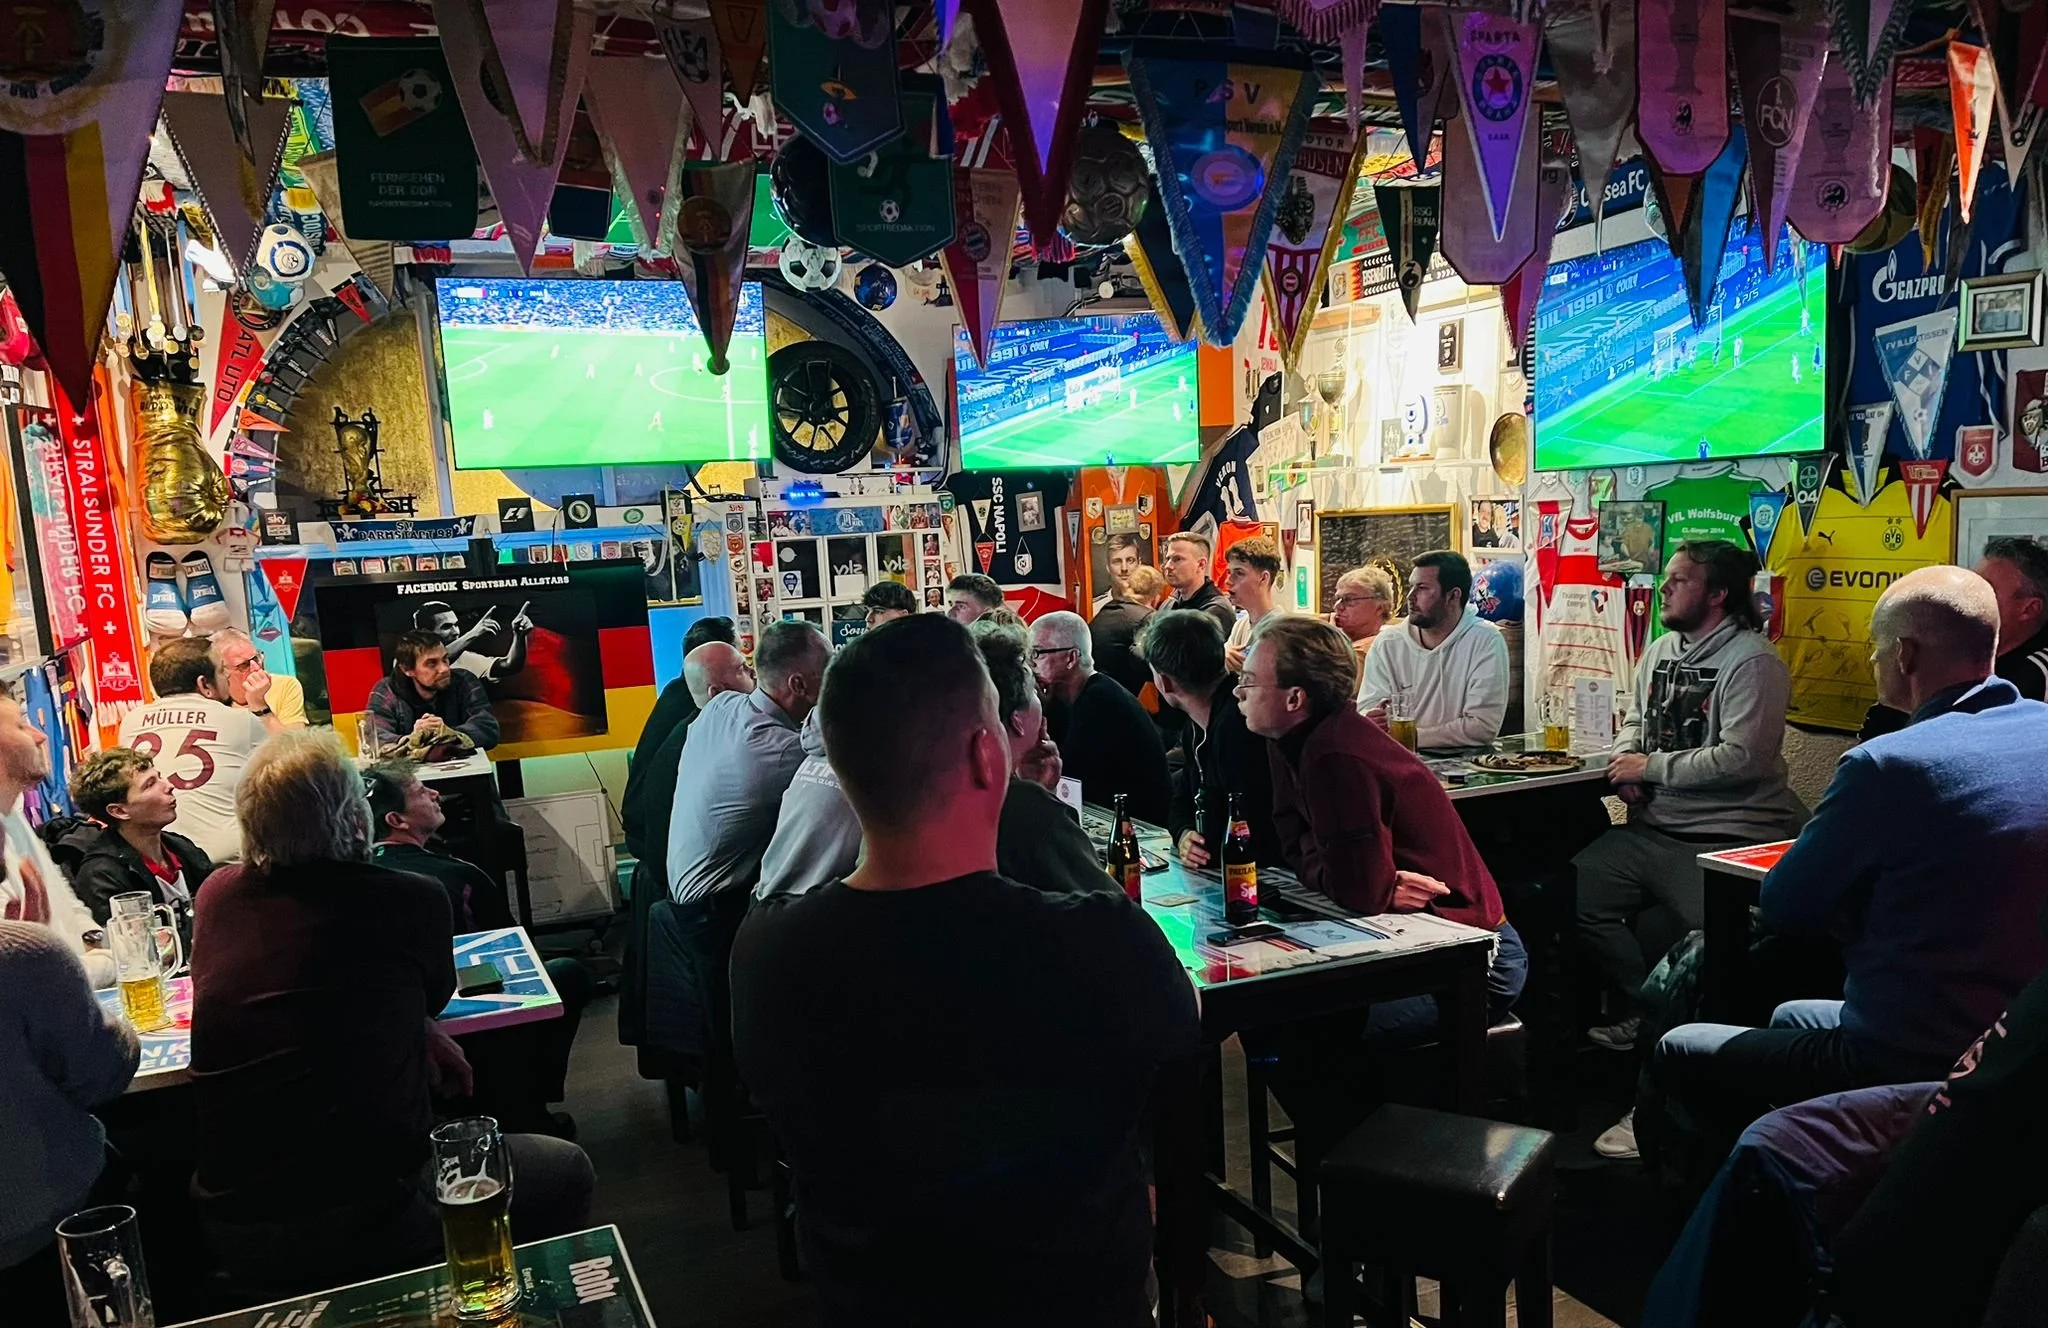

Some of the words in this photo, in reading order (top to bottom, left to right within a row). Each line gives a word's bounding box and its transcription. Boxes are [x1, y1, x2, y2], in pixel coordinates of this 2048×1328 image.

[1470, 30, 1520, 42] SPARTA
[1761, 104, 1794, 135] FCN
[1306, 134, 1344, 148] OTOR
[1297, 150, 1345, 175] AUSEN
[370, 172, 445, 184] FERNSEHEN
[1628, 169, 1645, 194] FC
[379, 185, 405, 196] DER
[410, 185, 438, 196] DDR
[855, 223, 936, 234] SPORTREDAKTION
[1896, 271, 1960, 300] GAZPRO
[1567, 287, 1604, 318] 1991
[1742, 288, 1759, 304] PS5
[230, 329, 255, 360] ATL
[1616, 359, 1635, 374] PS5
[216, 365, 243, 403] UTD
[1215, 460, 1237, 488] VERON
[992, 477, 1004, 504] SSC
[1797, 489, 1818, 504] 04
[72, 439, 112, 577] STRALSUNDER
[95, 583, 116, 609] FC
[267, 514, 287, 526] sky
[1667, 513, 1685, 525] VfL
[1687, 508, 1742, 527] Wolfsburg
[359, 529, 435, 541] DARMSTADT
[437, 529, 453, 539] 98
[993, 505, 1008, 554] NAPOLI
[1884, 528, 1902, 544] BVB
[397, 581, 458, 595] FACEBOOK
[1830, 570, 1906, 589] EVONI
[142, 708, 207, 727] MÜLLER
[1240, 882, 1257, 899] Sp
